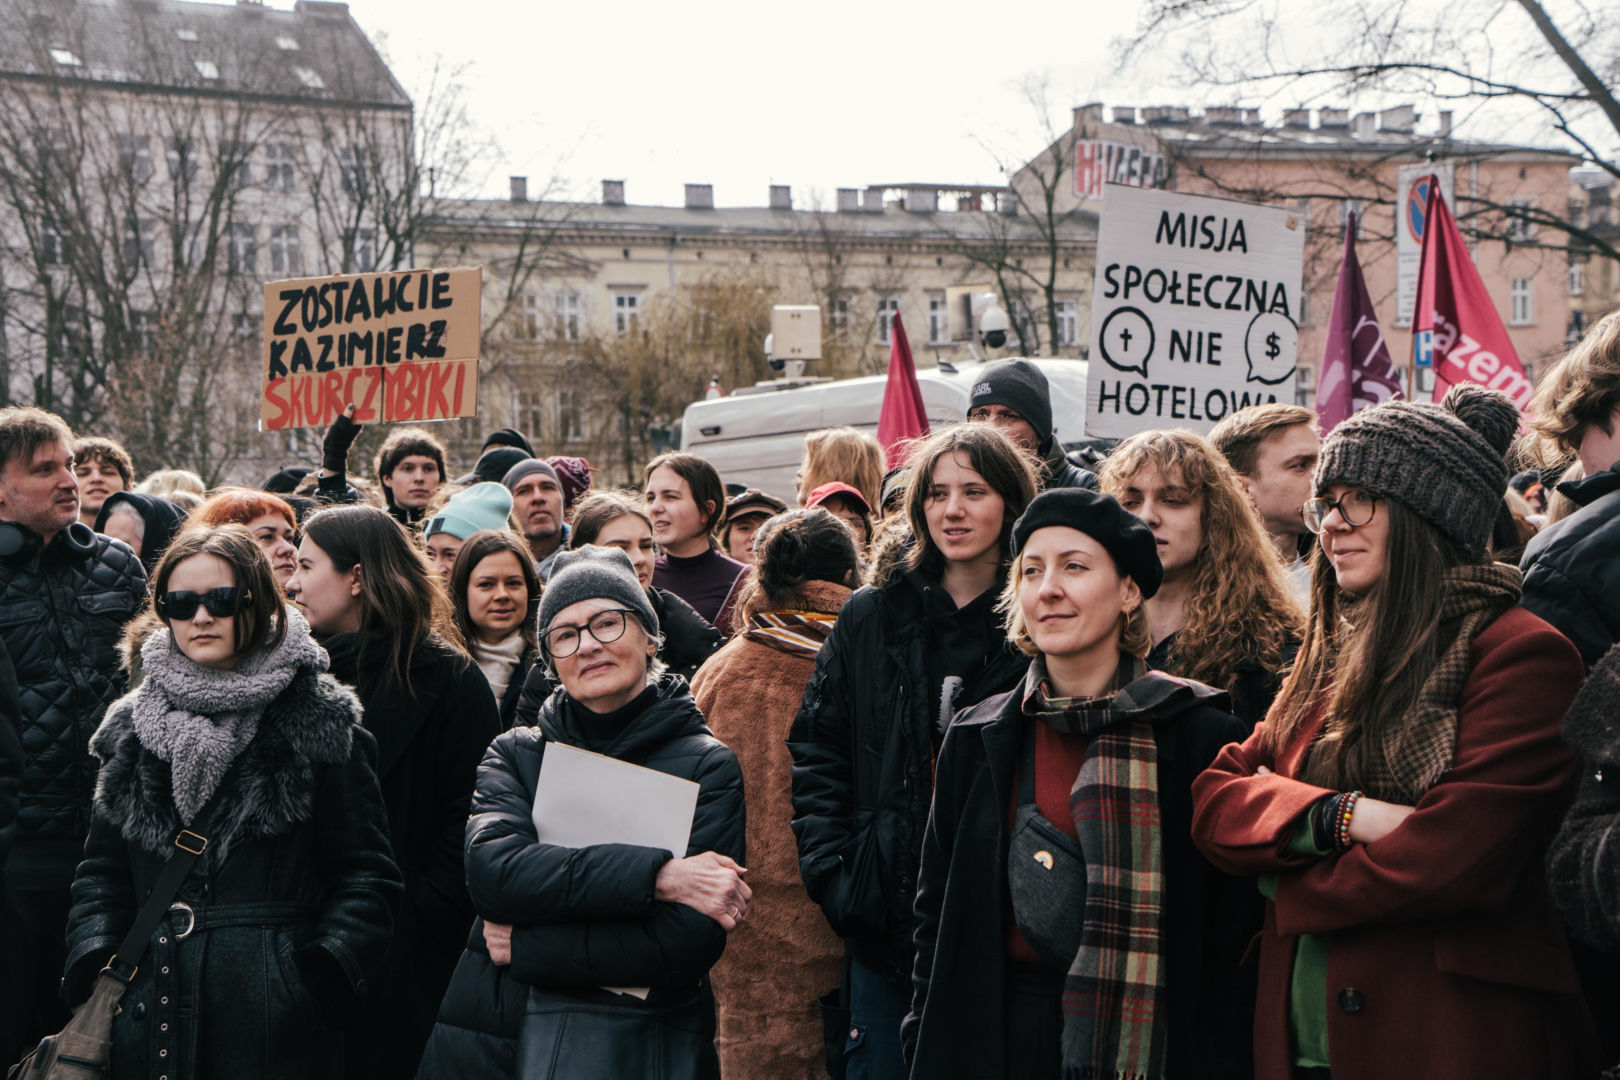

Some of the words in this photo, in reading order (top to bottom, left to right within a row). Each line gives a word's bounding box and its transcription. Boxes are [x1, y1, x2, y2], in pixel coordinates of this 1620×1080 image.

[1155, 210, 1248, 254] MISJA
[273, 272, 453, 336] ZOSTAWCIE
[1104, 263, 1289, 317] SPOŁECZNA
[269, 320, 447, 381] KAZIMIERZ
[1169, 329, 1222, 366] NIE
[264, 361, 466, 430] SKURCZYBYKI
[1098, 380, 1277, 422] HOTELOW
